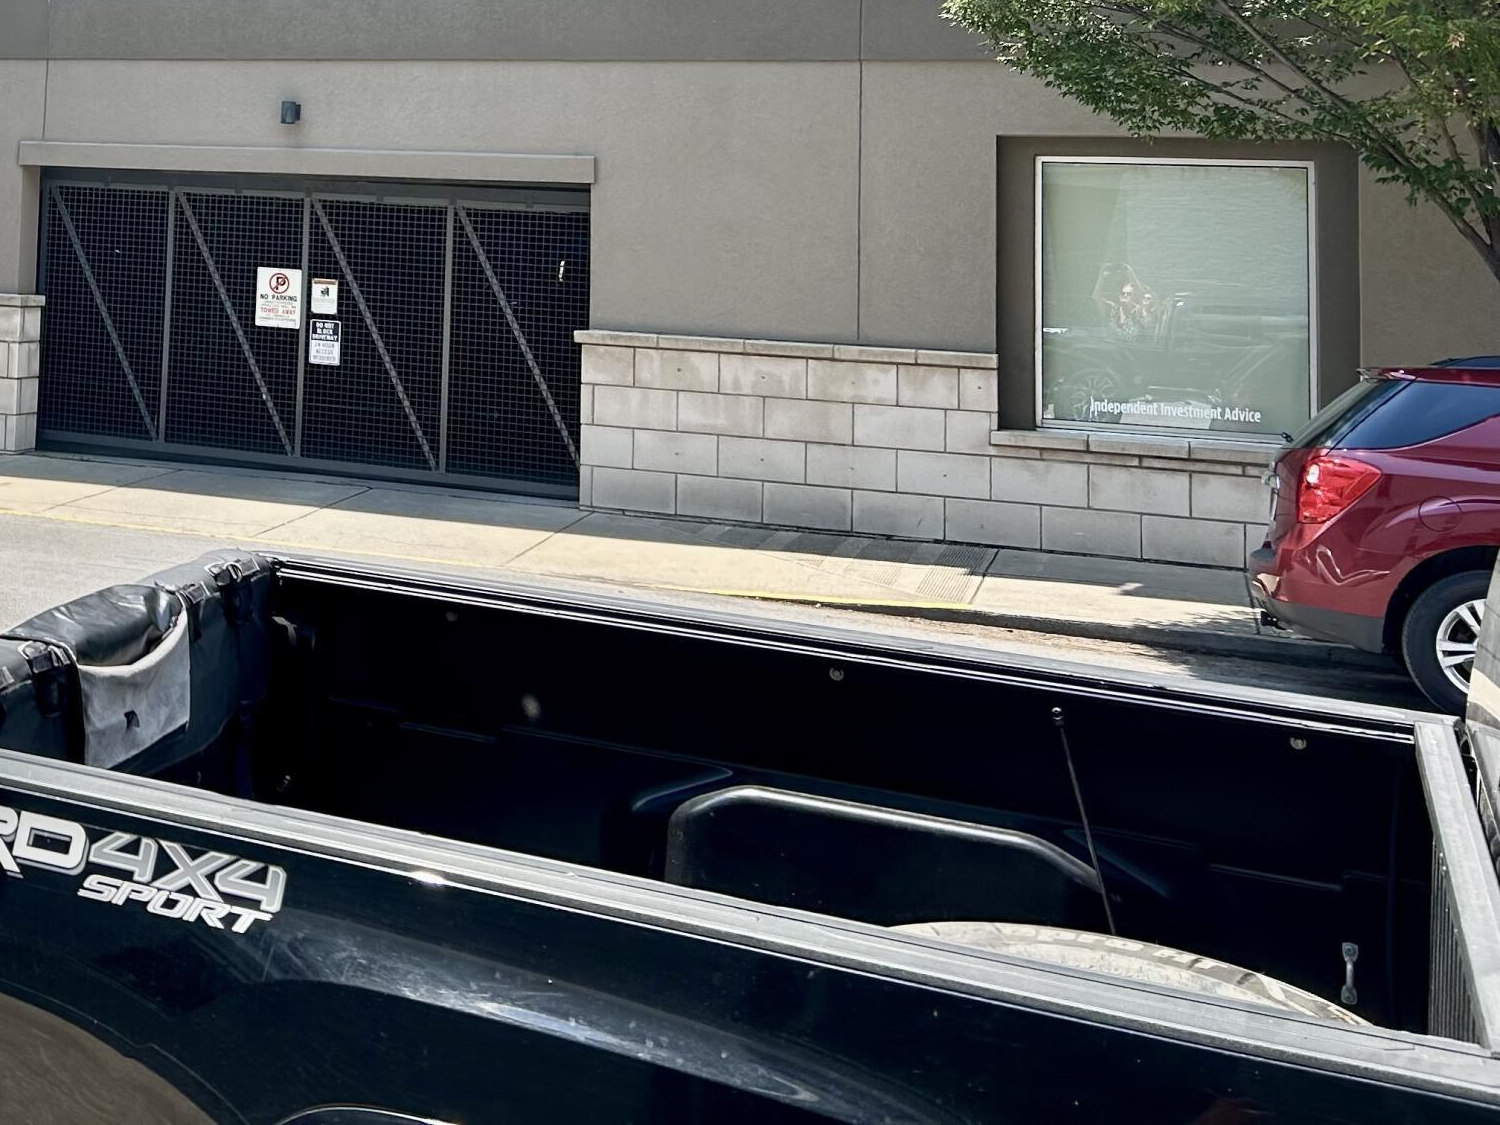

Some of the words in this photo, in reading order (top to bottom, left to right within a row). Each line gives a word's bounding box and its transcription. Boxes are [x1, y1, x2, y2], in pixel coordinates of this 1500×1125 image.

[272, 294, 298, 302] PARKING
[1090, 398, 1157, 415] Independent
[1160, 402, 1222, 420] Investment
[1224, 407, 1262, 423] Advice
[77, 873, 273, 934] SPORT
